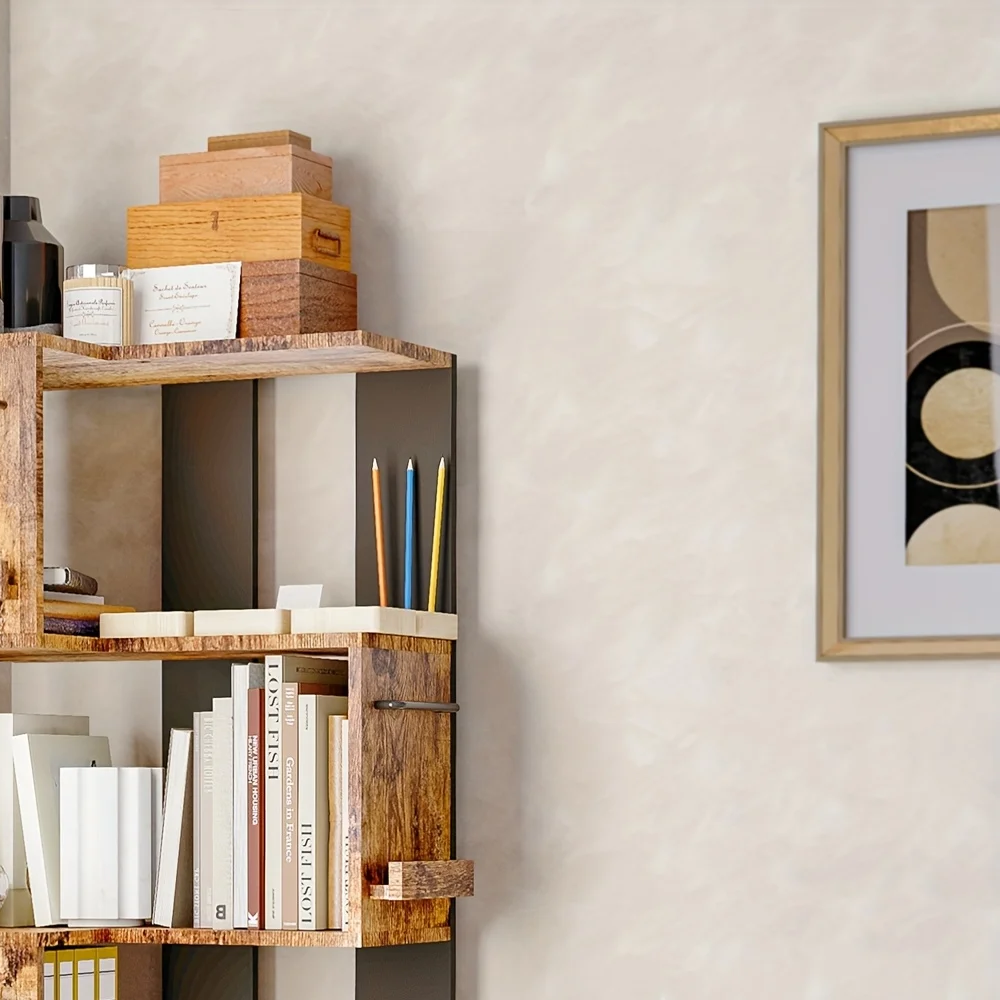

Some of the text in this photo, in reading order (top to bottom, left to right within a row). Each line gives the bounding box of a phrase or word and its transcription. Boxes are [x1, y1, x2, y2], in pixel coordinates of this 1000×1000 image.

[268, 664, 280, 780] LOST FISH
[285, 756, 295, 863] Gardens in France
[301, 823, 313, 923] LOST FISH
